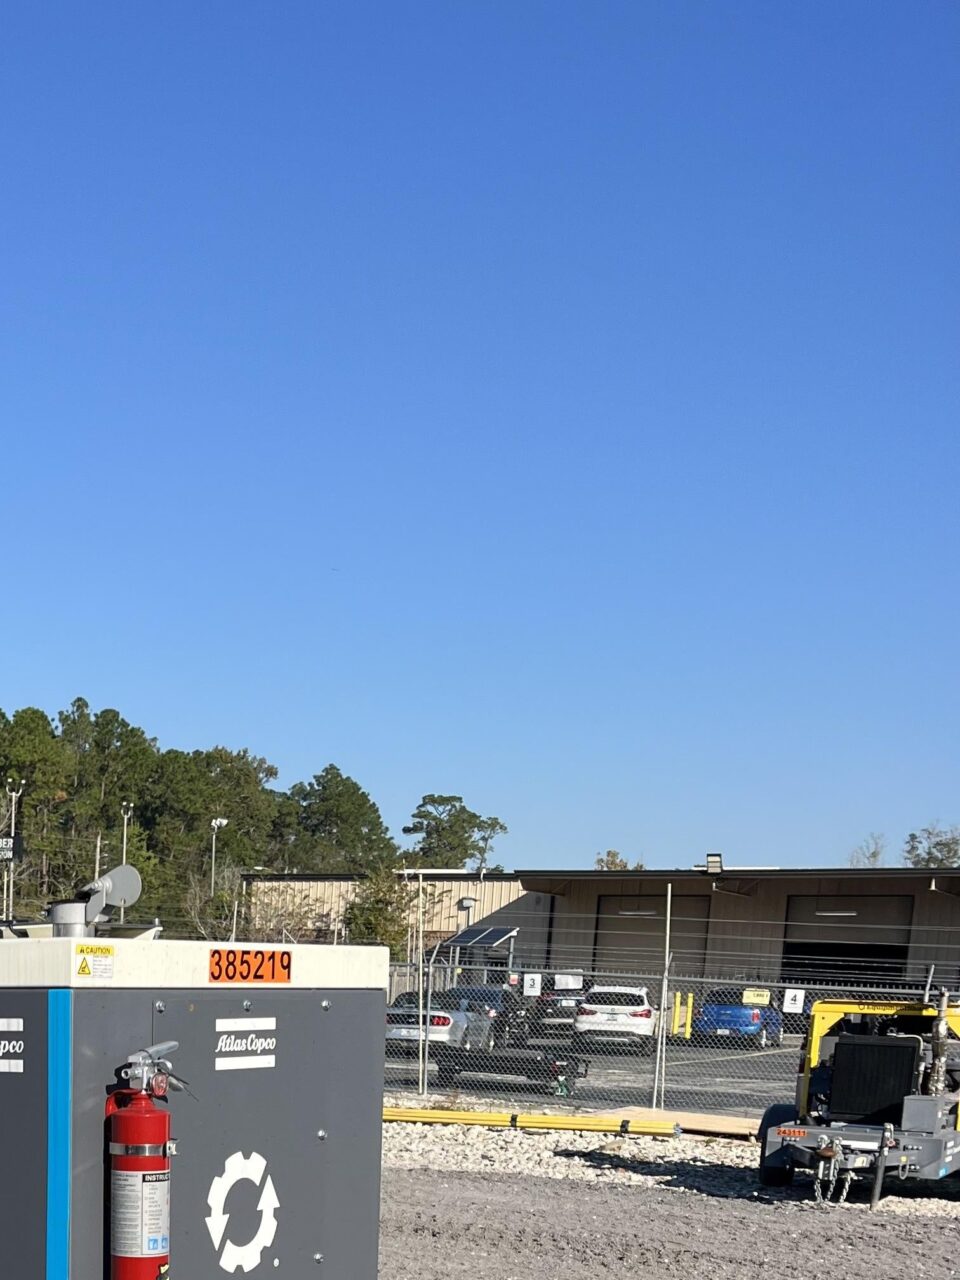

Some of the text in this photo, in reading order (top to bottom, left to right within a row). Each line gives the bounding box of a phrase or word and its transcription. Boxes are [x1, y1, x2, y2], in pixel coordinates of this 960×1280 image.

[85, 946, 111, 955] CAUTION
[210, 949, 292, 981] 385219
[529, 978, 536, 987] 3
[790, 993, 798, 1003] 4
[215, 1033, 277, 1054] Atlas Copco
